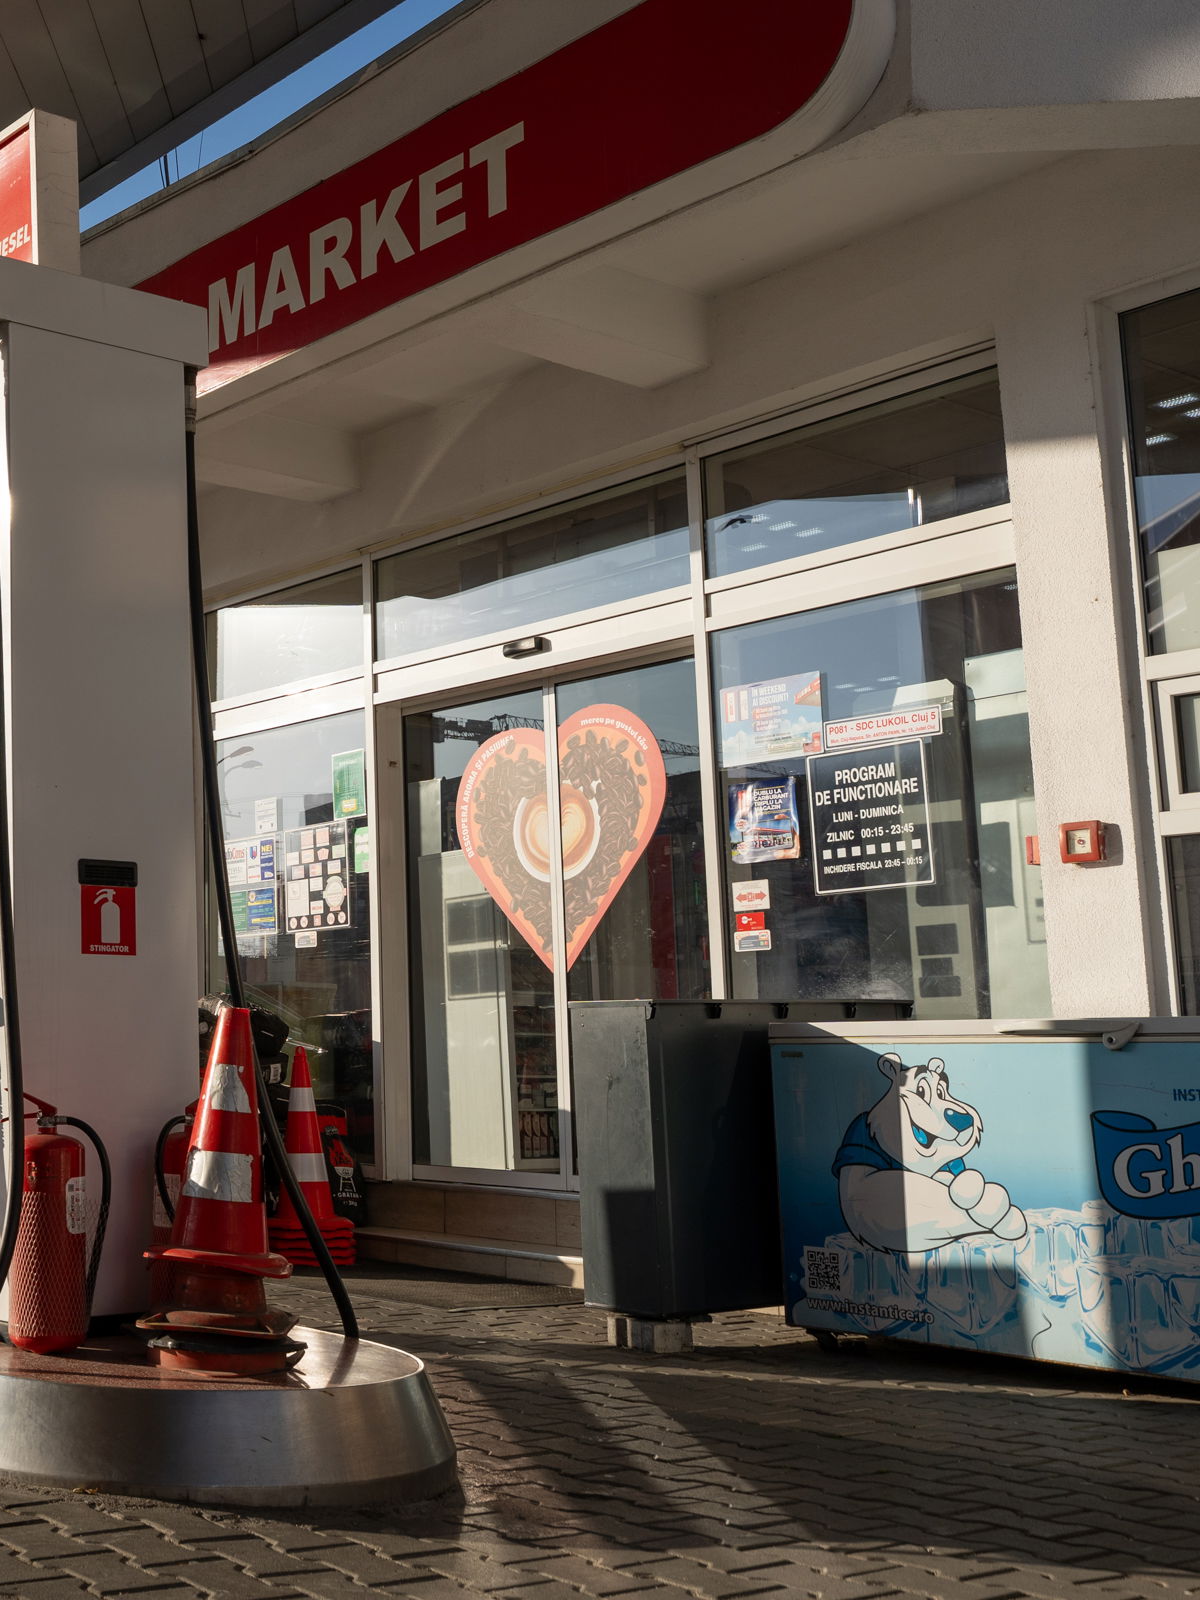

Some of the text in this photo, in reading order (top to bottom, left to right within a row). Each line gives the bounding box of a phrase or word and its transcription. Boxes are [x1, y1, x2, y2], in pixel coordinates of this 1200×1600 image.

[208, 120, 525, 354] MARKET
[580, 717, 605, 726] mereu
[604, 717, 615, 725] pe
[615, 720, 638, 739] gustul
[855, 720, 874, 731] SDC
[876, 715, 909, 728] LUKOIL
[911, 711, 929, 723] Cluj
[930, 711, 936, 720] 5
[834, 762, 896, 786] PROGRAM
[462, 770, 478, 802] AROMA
[815, 777, 919, 807] DE FUNCTIONARE
[832, 811, 853, 823] LUNI
[859, 804, 905, 820] DUMINICA
[826, 830, 855, 843] ZILNIC
[860, 826, 884, 839] 00:15
[890, 822, 915, 835] 23:45
[823, 864, 856, 875] INCHIDERE
[856, 860, 883, 871] FISCALA
[884, 858, 901, 868] 23:45
[906, 856, 923, 866] 00:15
[807, 1297, 935, 1325] www.instantice.ro
